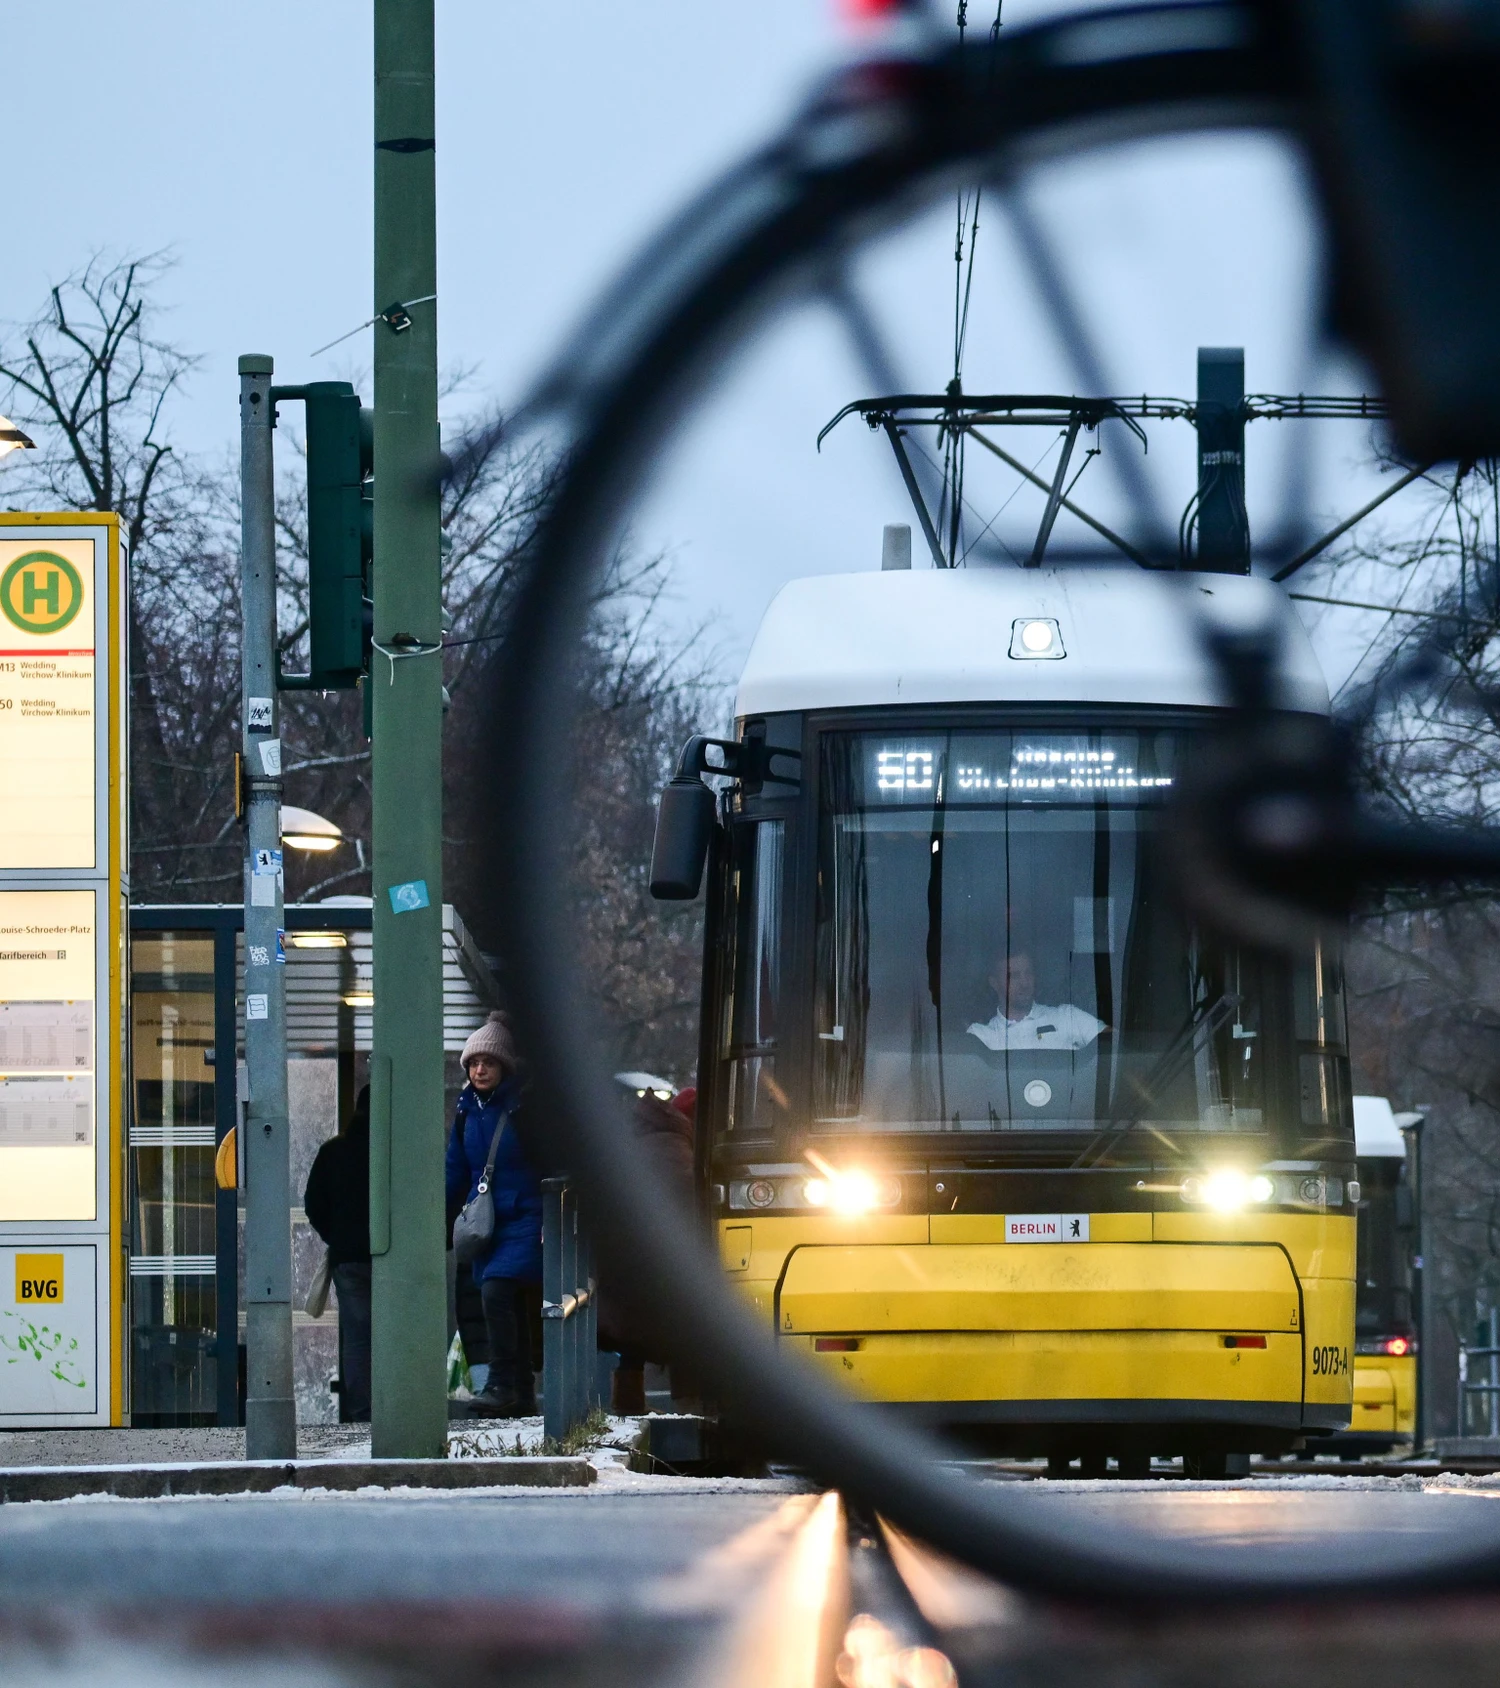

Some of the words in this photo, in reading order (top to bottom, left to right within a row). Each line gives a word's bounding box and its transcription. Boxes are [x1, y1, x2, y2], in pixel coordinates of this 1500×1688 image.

[23, 571, 59, 614] H
[20, 662, 56, 670] Wedding
[20, 700, 55, 708] Wedding
[0, 926, 91, 934] ouise-Schroeder-Platz
[1011, 1223, 1056, 1234] BERLIN
[22, 1279, 58, 1298] BVG
[1313, 1346, 1348, 1375] 9073-A
